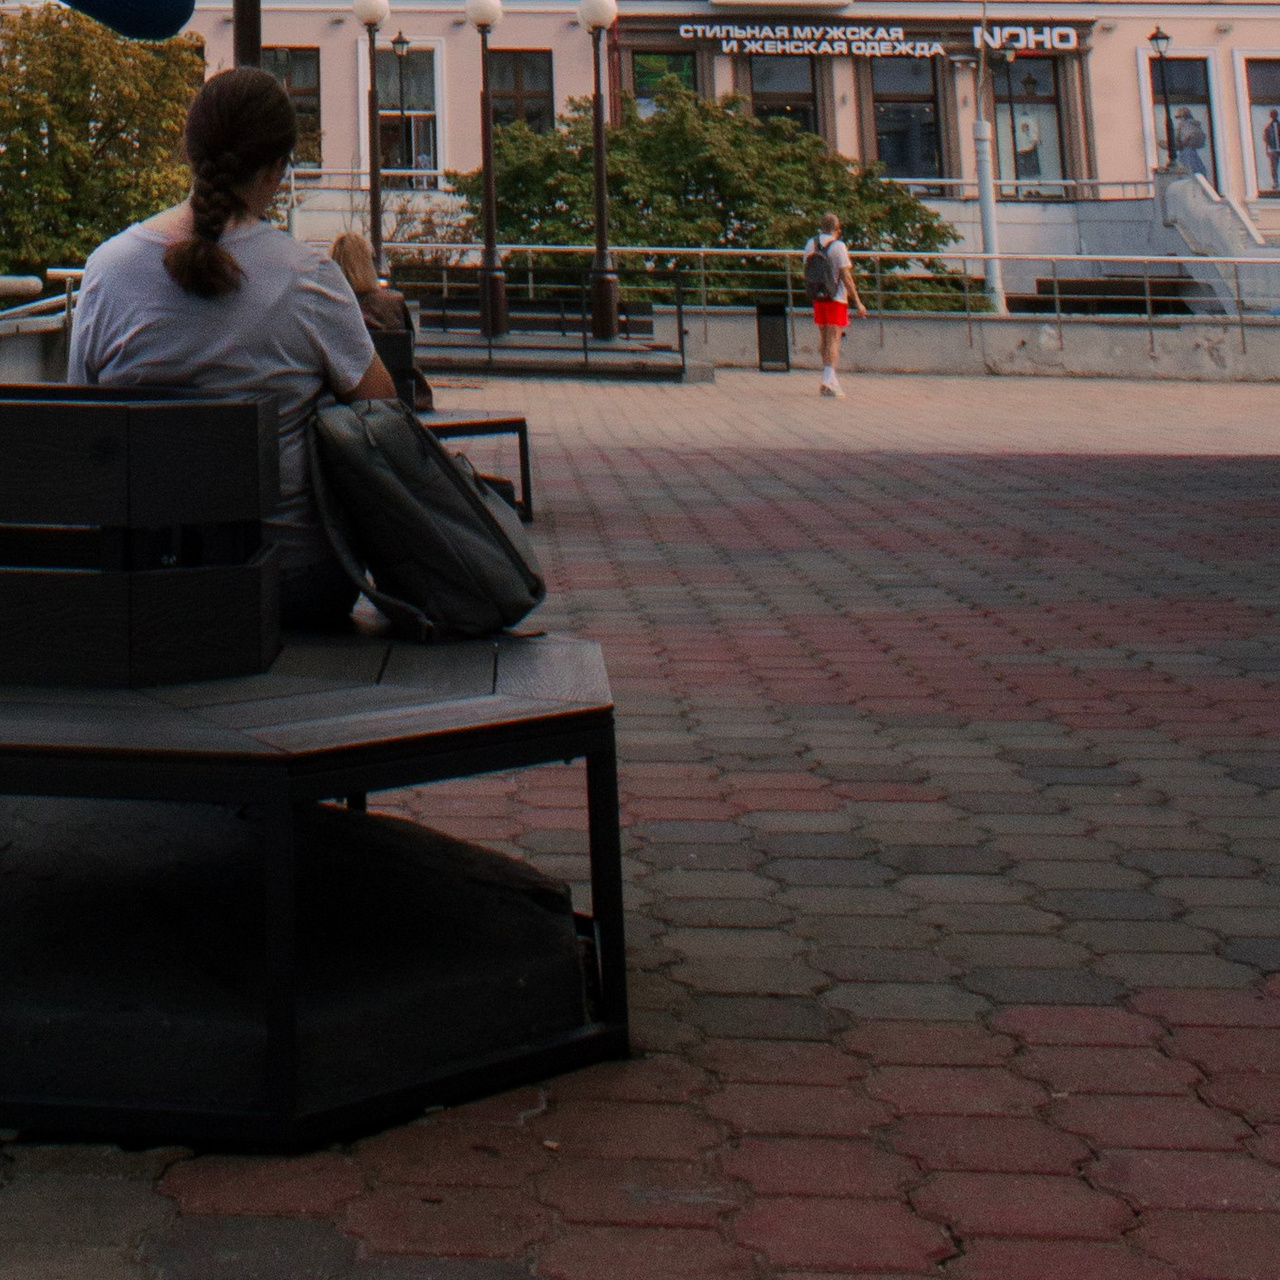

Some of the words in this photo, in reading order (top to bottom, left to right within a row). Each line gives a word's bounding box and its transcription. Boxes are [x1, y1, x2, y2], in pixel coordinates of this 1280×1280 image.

[678, 24, 789, 40] СТИЛЬНАЯ
[792, 26, 905, 41] МУЖСКАЯ
[972, 26, 1079, 50] NOHO
[721, 39, 738, 54] И
[743, 40, 848, 55] ЖЕНСКАЯ
[851, 41, 947, 58] ОДЕЖДА
